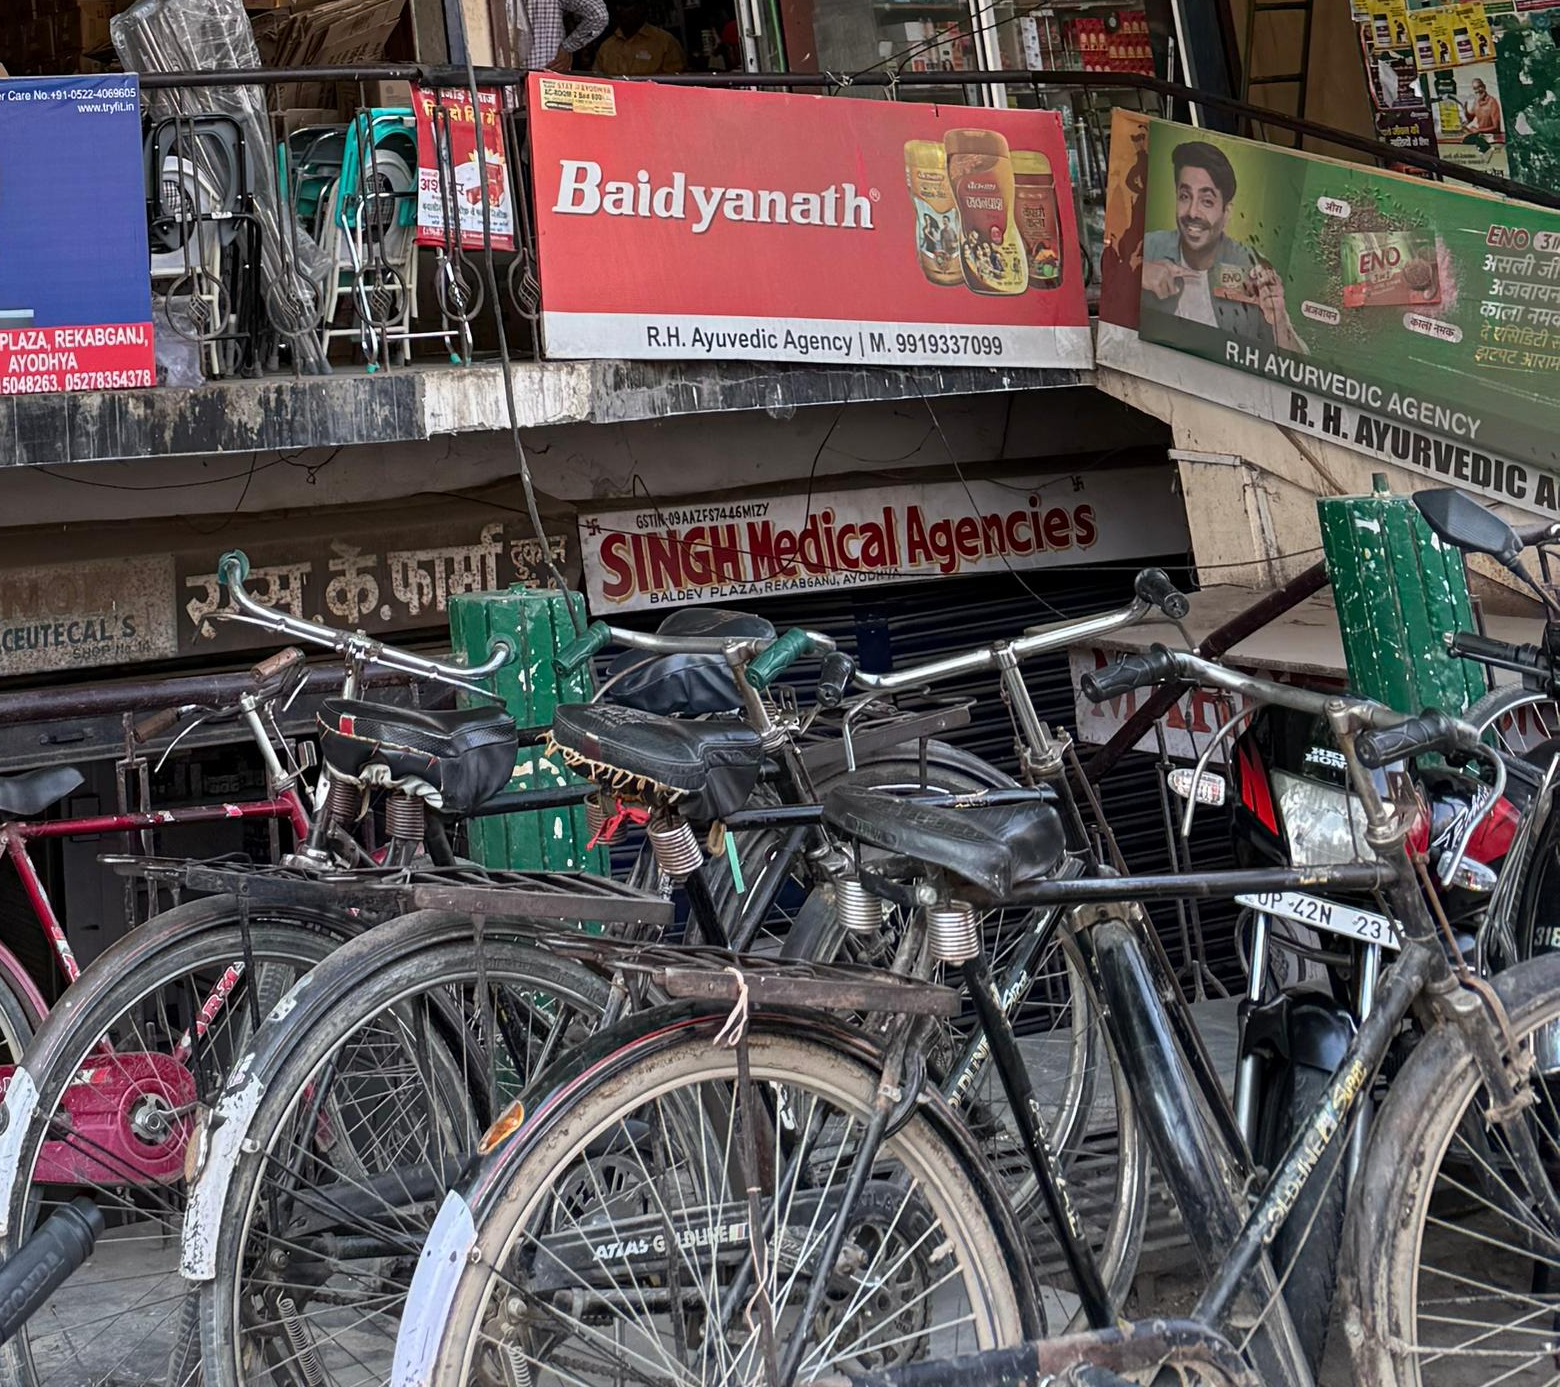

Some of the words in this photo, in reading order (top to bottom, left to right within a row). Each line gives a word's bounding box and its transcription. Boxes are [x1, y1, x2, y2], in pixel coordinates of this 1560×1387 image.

[7, 89, 32, 102] Care
[77, 101, 135, 115] www.tryfit.in
[552, 159, 874, 234] Baidyanath
[1486, 223, 1531, 251] ENO
[1357, 244, 1402, 277] ENO
[1482, 253, 1536, 279] असली
[1221, 271, 1242, 285] ENO
[1481, 300, 1523, 323] काला
[0, 329, 51, 352] PLAZA,
[54, 326, 149, 349] REKABGANJ,
[1410, 315, 1433, 333] काला
[1433, 321, 1456, 340] नमक
[646, 325, 687, 349] R.H.
[690, 326, 779, 354] Ayuvedic
[782, 328, 853, 357] Agency
[869, 331, 892, 354] M.
[895, 333, 1004, 357] 9919337099
[8, 351, 79, 374] AYODHYA
[65, 369, 152, 392] 05278354378
[1225, 340, 1260, 368] R.H
[1264, 354, 1382, 408] AYURVEDIC
[1387, 392, 1482, 440] AGENCY
[1290, 391, 1315, 428] R.
[1322, 402, 1348, 440] H.
[1354, 415, 1528, 500] AYURVEDIC
[600, 518, 748, 604] SINGH
[747, 505, 900, 584] Medical
[907, 494, 1099, 577] Agencies
[650, 587, 703, 605] BALDEV
[710, 581, 763, 601] PLAZA,
[842, 568, 902, 586] AYODHYA
[1292, 898, 1333, 926] 42N
[593, 1238, 649, 1262] ATLAS
